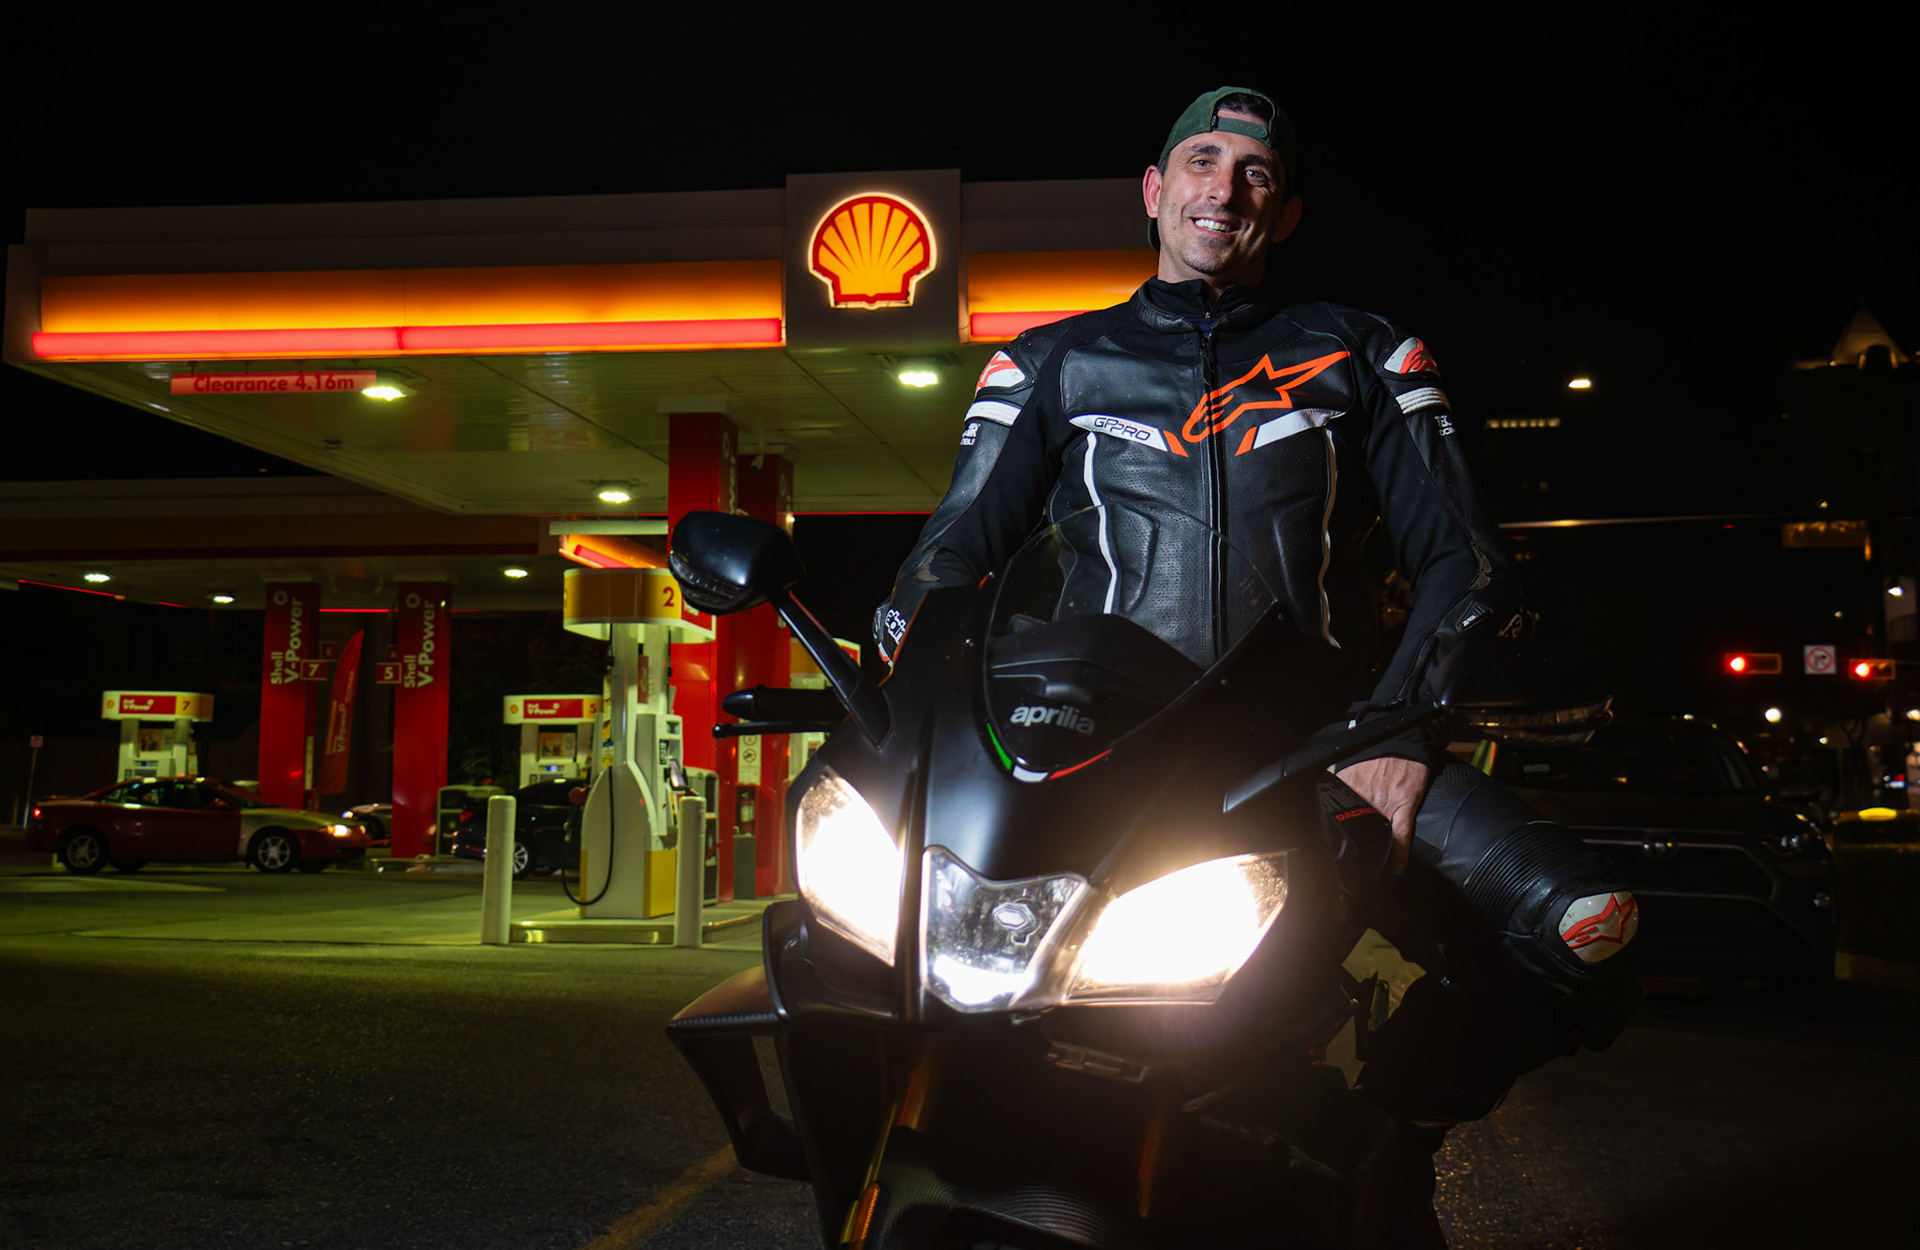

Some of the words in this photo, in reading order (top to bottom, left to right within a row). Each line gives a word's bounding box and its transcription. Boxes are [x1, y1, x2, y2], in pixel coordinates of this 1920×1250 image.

[193, 374, 289, 393] Clearance
[295, 374, 355, 391] 4.16m
[663, 586, 674, 607] 2
[284, 597, 302, 684] V-Power
[417, 600, 435, 688] V-Power
[270, 652, 283, 684] Shell
[309, 663, 319, 677] 7
[384, 667, 393, 680] 5
[404, 655, 416, 688] Shell
[183, 701, 190, 711] 7
[590, 703, 596, 713] 5
[1010, 705, 1095, 735] aprilia
